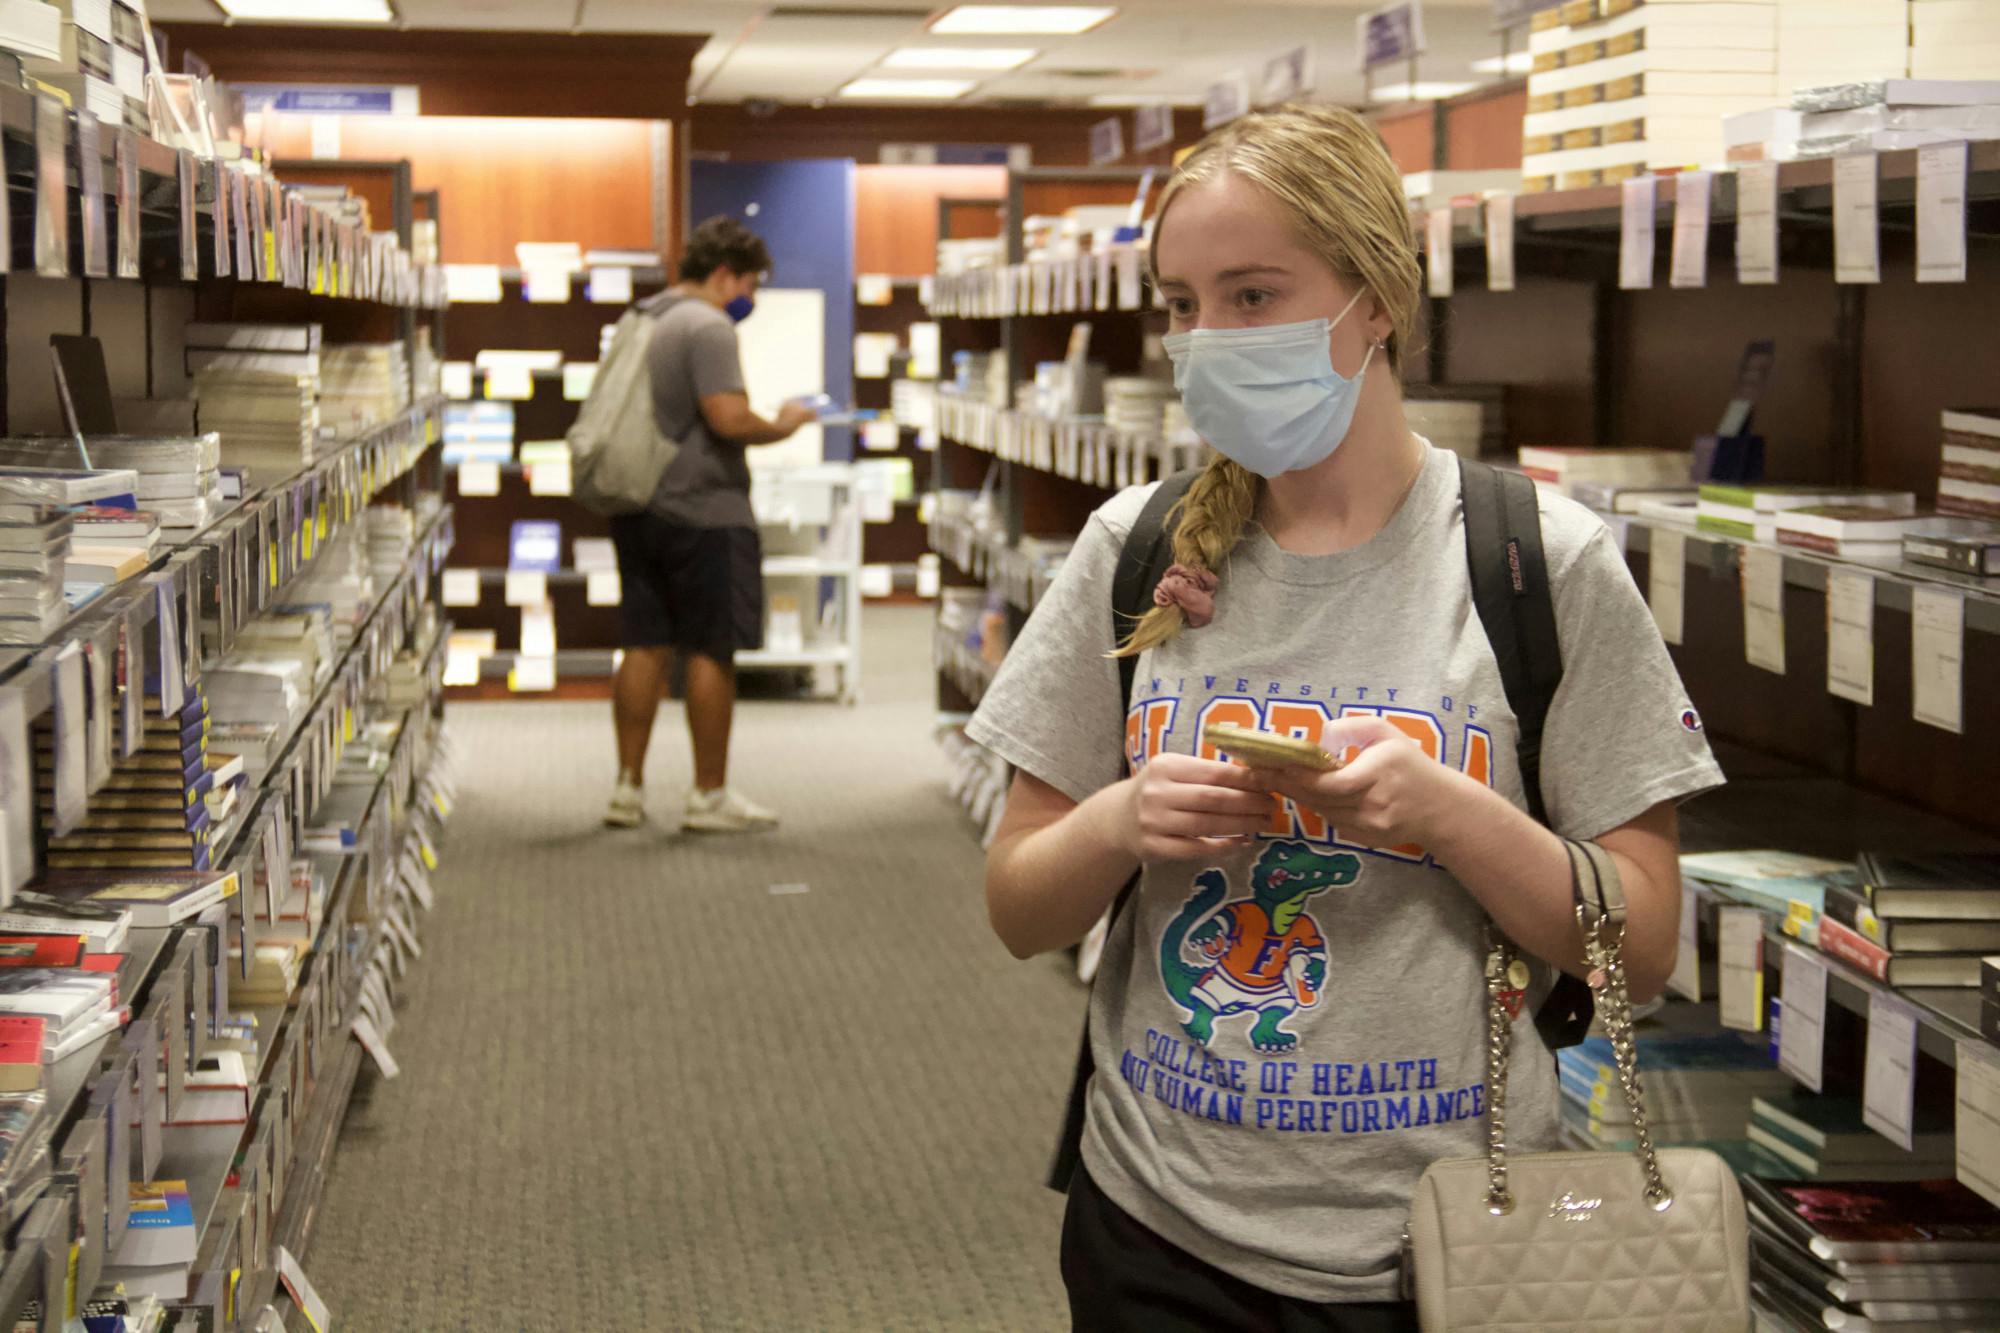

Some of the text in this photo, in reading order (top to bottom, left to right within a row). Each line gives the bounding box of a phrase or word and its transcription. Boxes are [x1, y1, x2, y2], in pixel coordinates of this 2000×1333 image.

[1441, 695, 1479, 720] OF
[1145, 1028, 1438, 1096] COLLEGE OF HEALTH
[1256, 1084, 1486, 1133] PERFORMANCE
